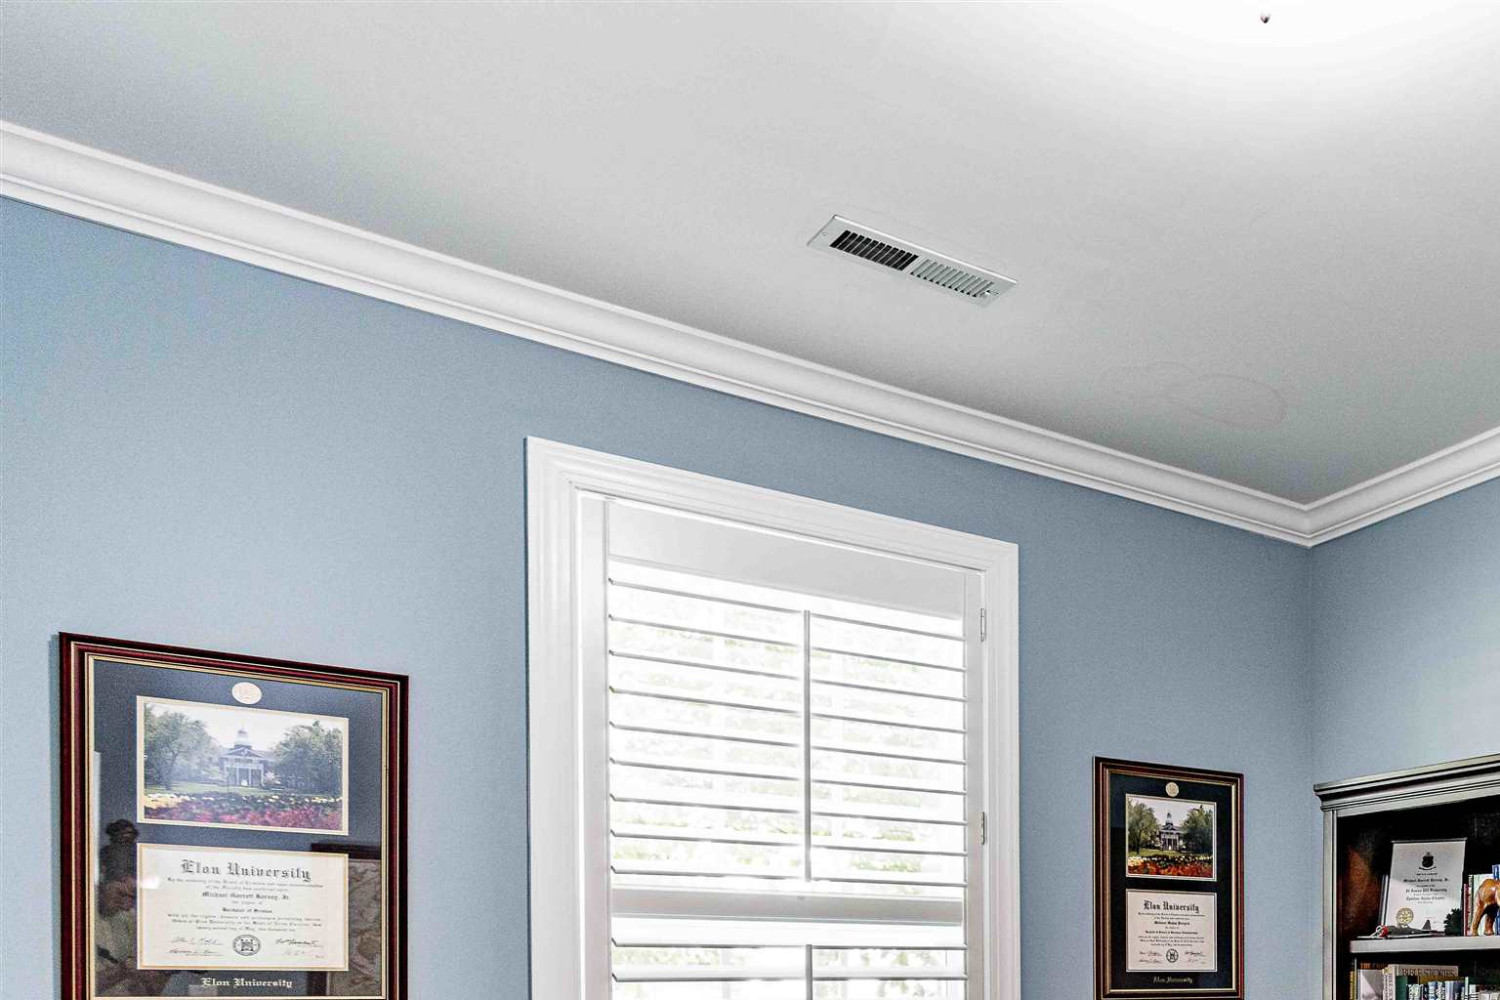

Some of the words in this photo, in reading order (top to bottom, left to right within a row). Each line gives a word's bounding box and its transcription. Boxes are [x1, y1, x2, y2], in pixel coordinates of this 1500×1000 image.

[181, 859, 220, 876] Elon
[226, 862, 312, 882] University
[1144, 900, 1160, 910] Elon
[1163, 901, 1200, 914] University
[1424, 968, 1455, 976] STORIES
[201, 977, 230, 987] Elon
[234, 978, 293, 988] University
